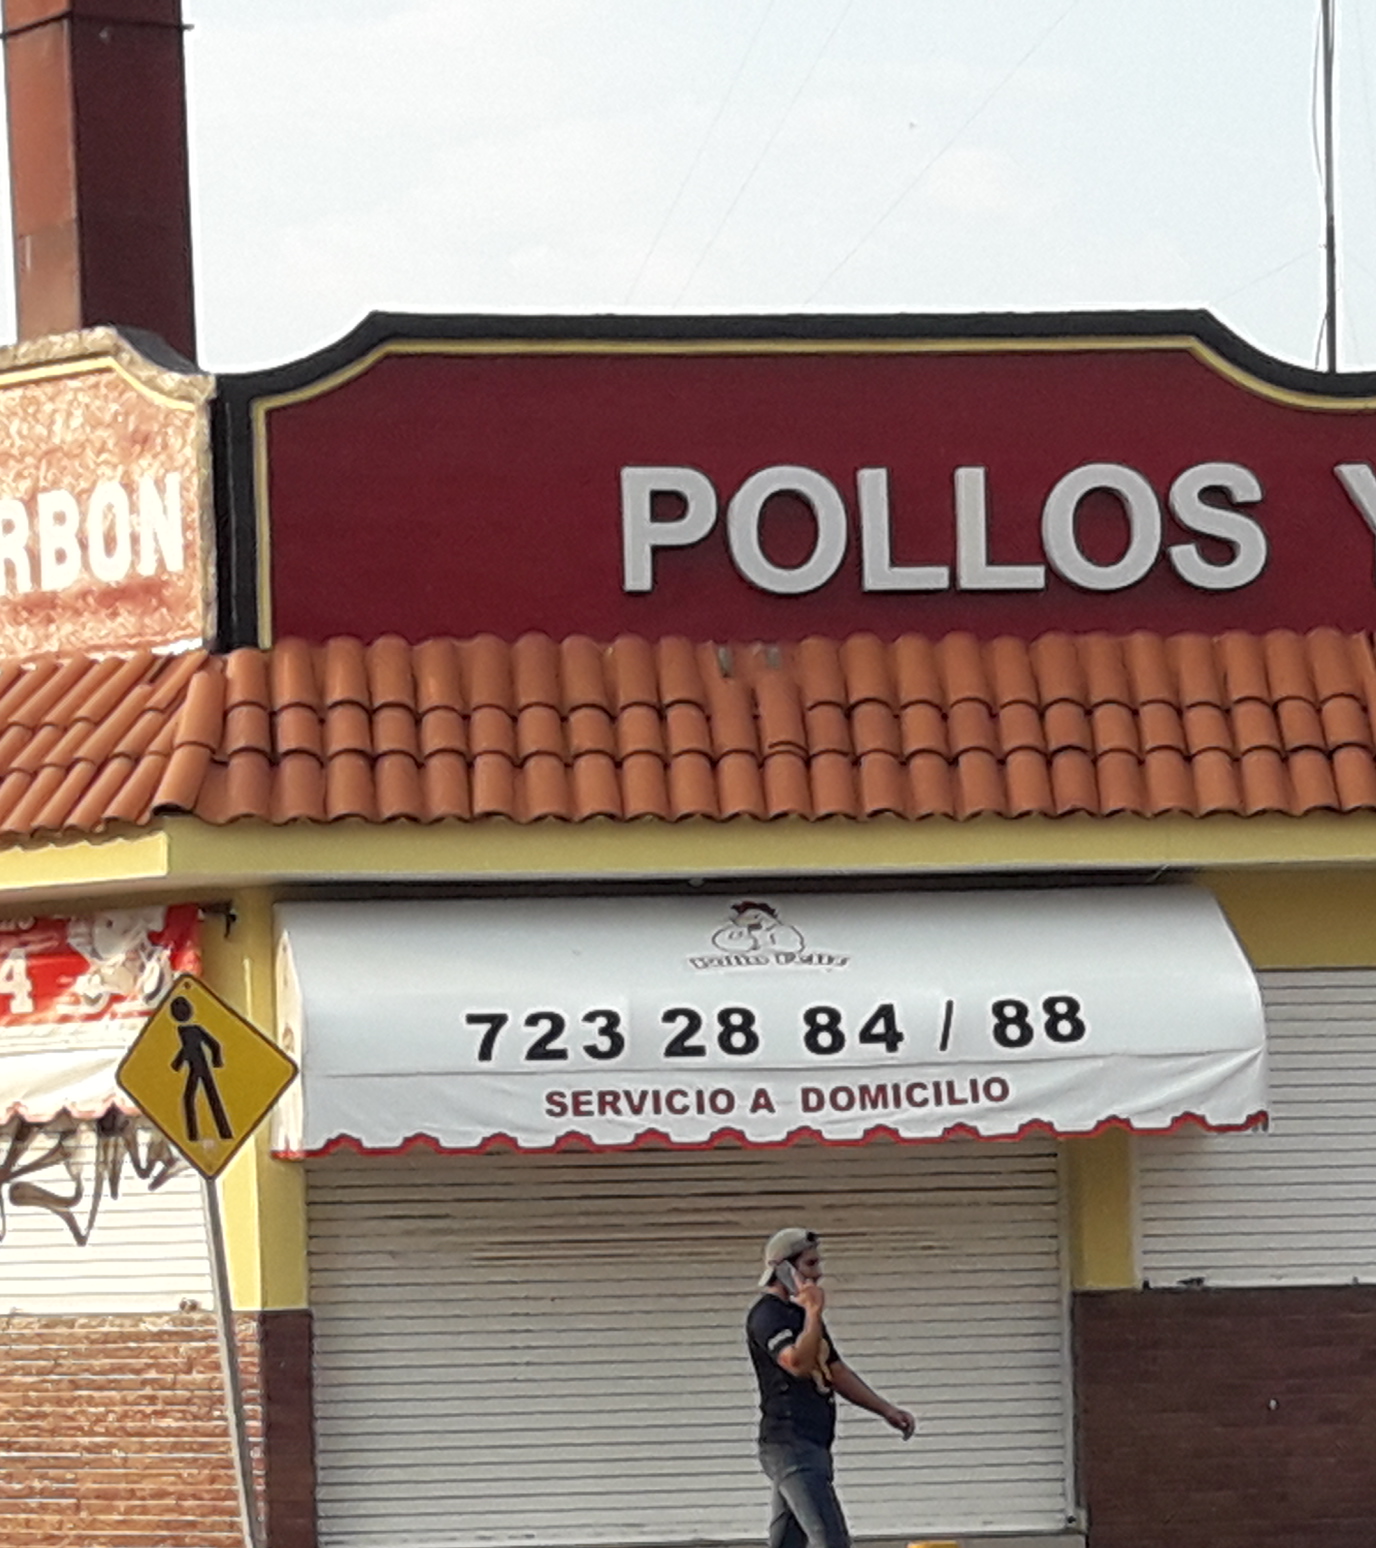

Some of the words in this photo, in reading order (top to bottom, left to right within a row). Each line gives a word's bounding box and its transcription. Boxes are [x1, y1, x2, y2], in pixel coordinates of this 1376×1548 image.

[620, 460, 1269, 594] POLLOS
[465, 1010, 625, 1061] 723
[660, 1007, 760, 1057] 28
[803, 1004, 904, 1055] 84
[939, 1000, 954, 1052] /
[990, 996, 1086, 1048] 88
[544, 1087, 736, 1118] SERVICIO
[748, 1088, 776, 1113] A
[801, 1077, 1010, 1113] DOMICILIO
